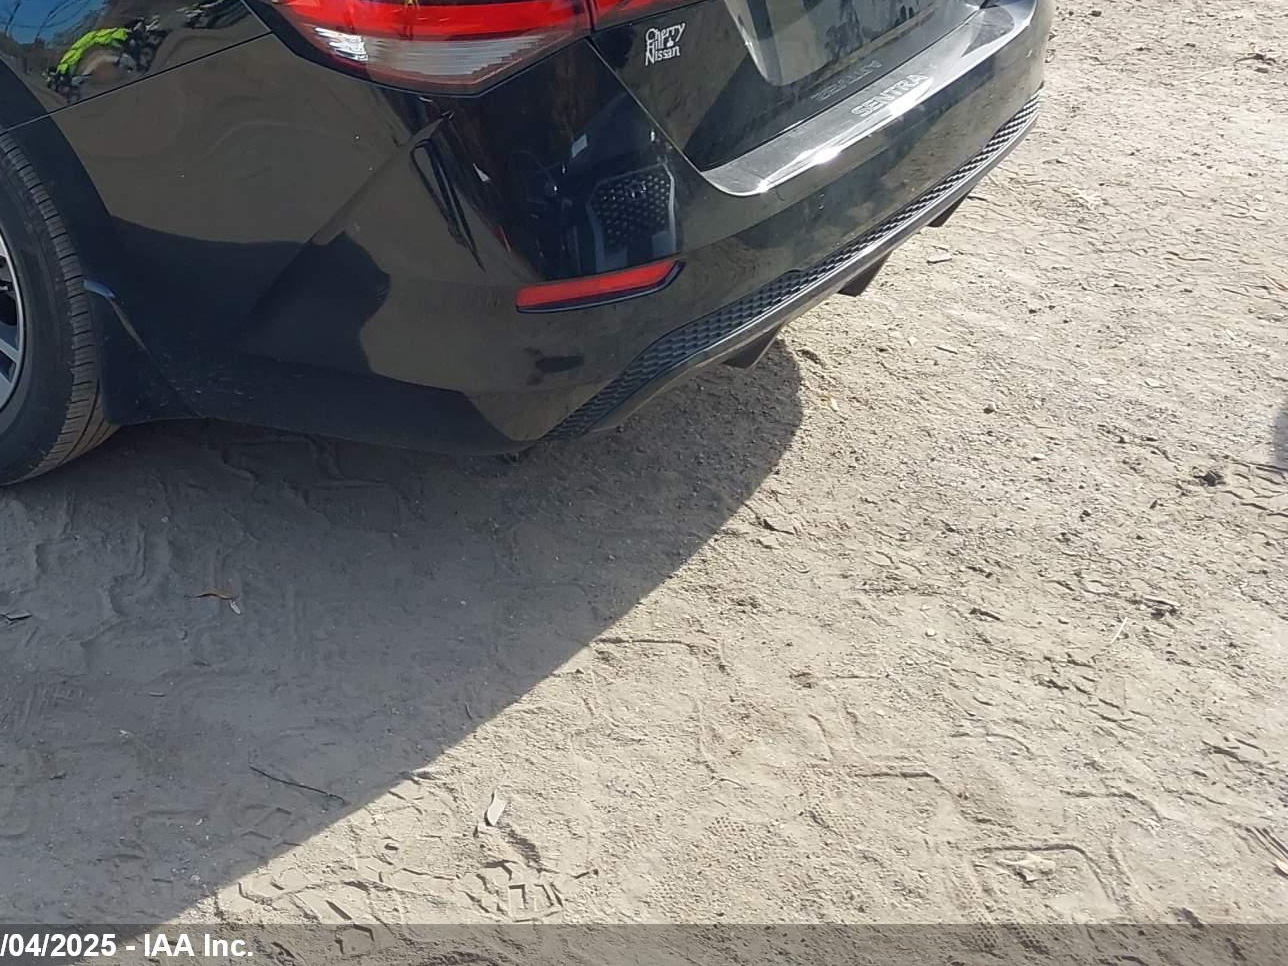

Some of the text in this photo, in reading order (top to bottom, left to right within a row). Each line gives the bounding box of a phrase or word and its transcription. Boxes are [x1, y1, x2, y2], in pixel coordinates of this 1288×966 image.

[645, 23, 686, 43] Cherry
[645, 45, 681, 66] Nissan
[851, 74, 929, 117] SENTRA
